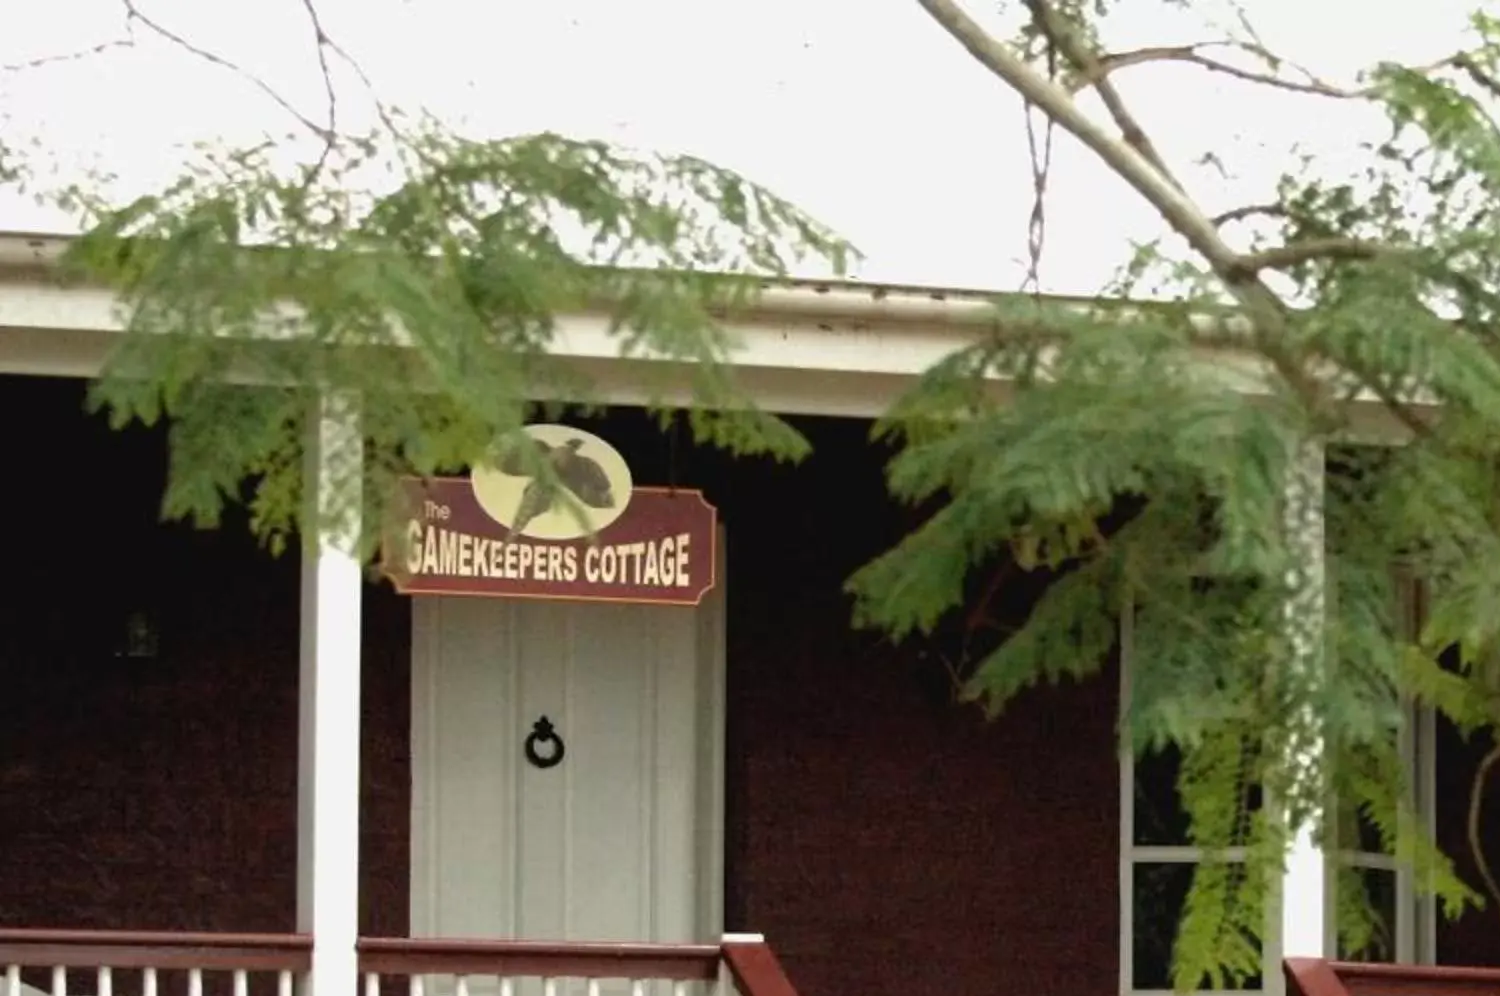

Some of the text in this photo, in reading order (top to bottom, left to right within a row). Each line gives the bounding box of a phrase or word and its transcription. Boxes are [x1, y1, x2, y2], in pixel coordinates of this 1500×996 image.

[425, 500, 450, 520] The
[406, 518, 690, 587] GAMEKEEPERS COTTAGE
